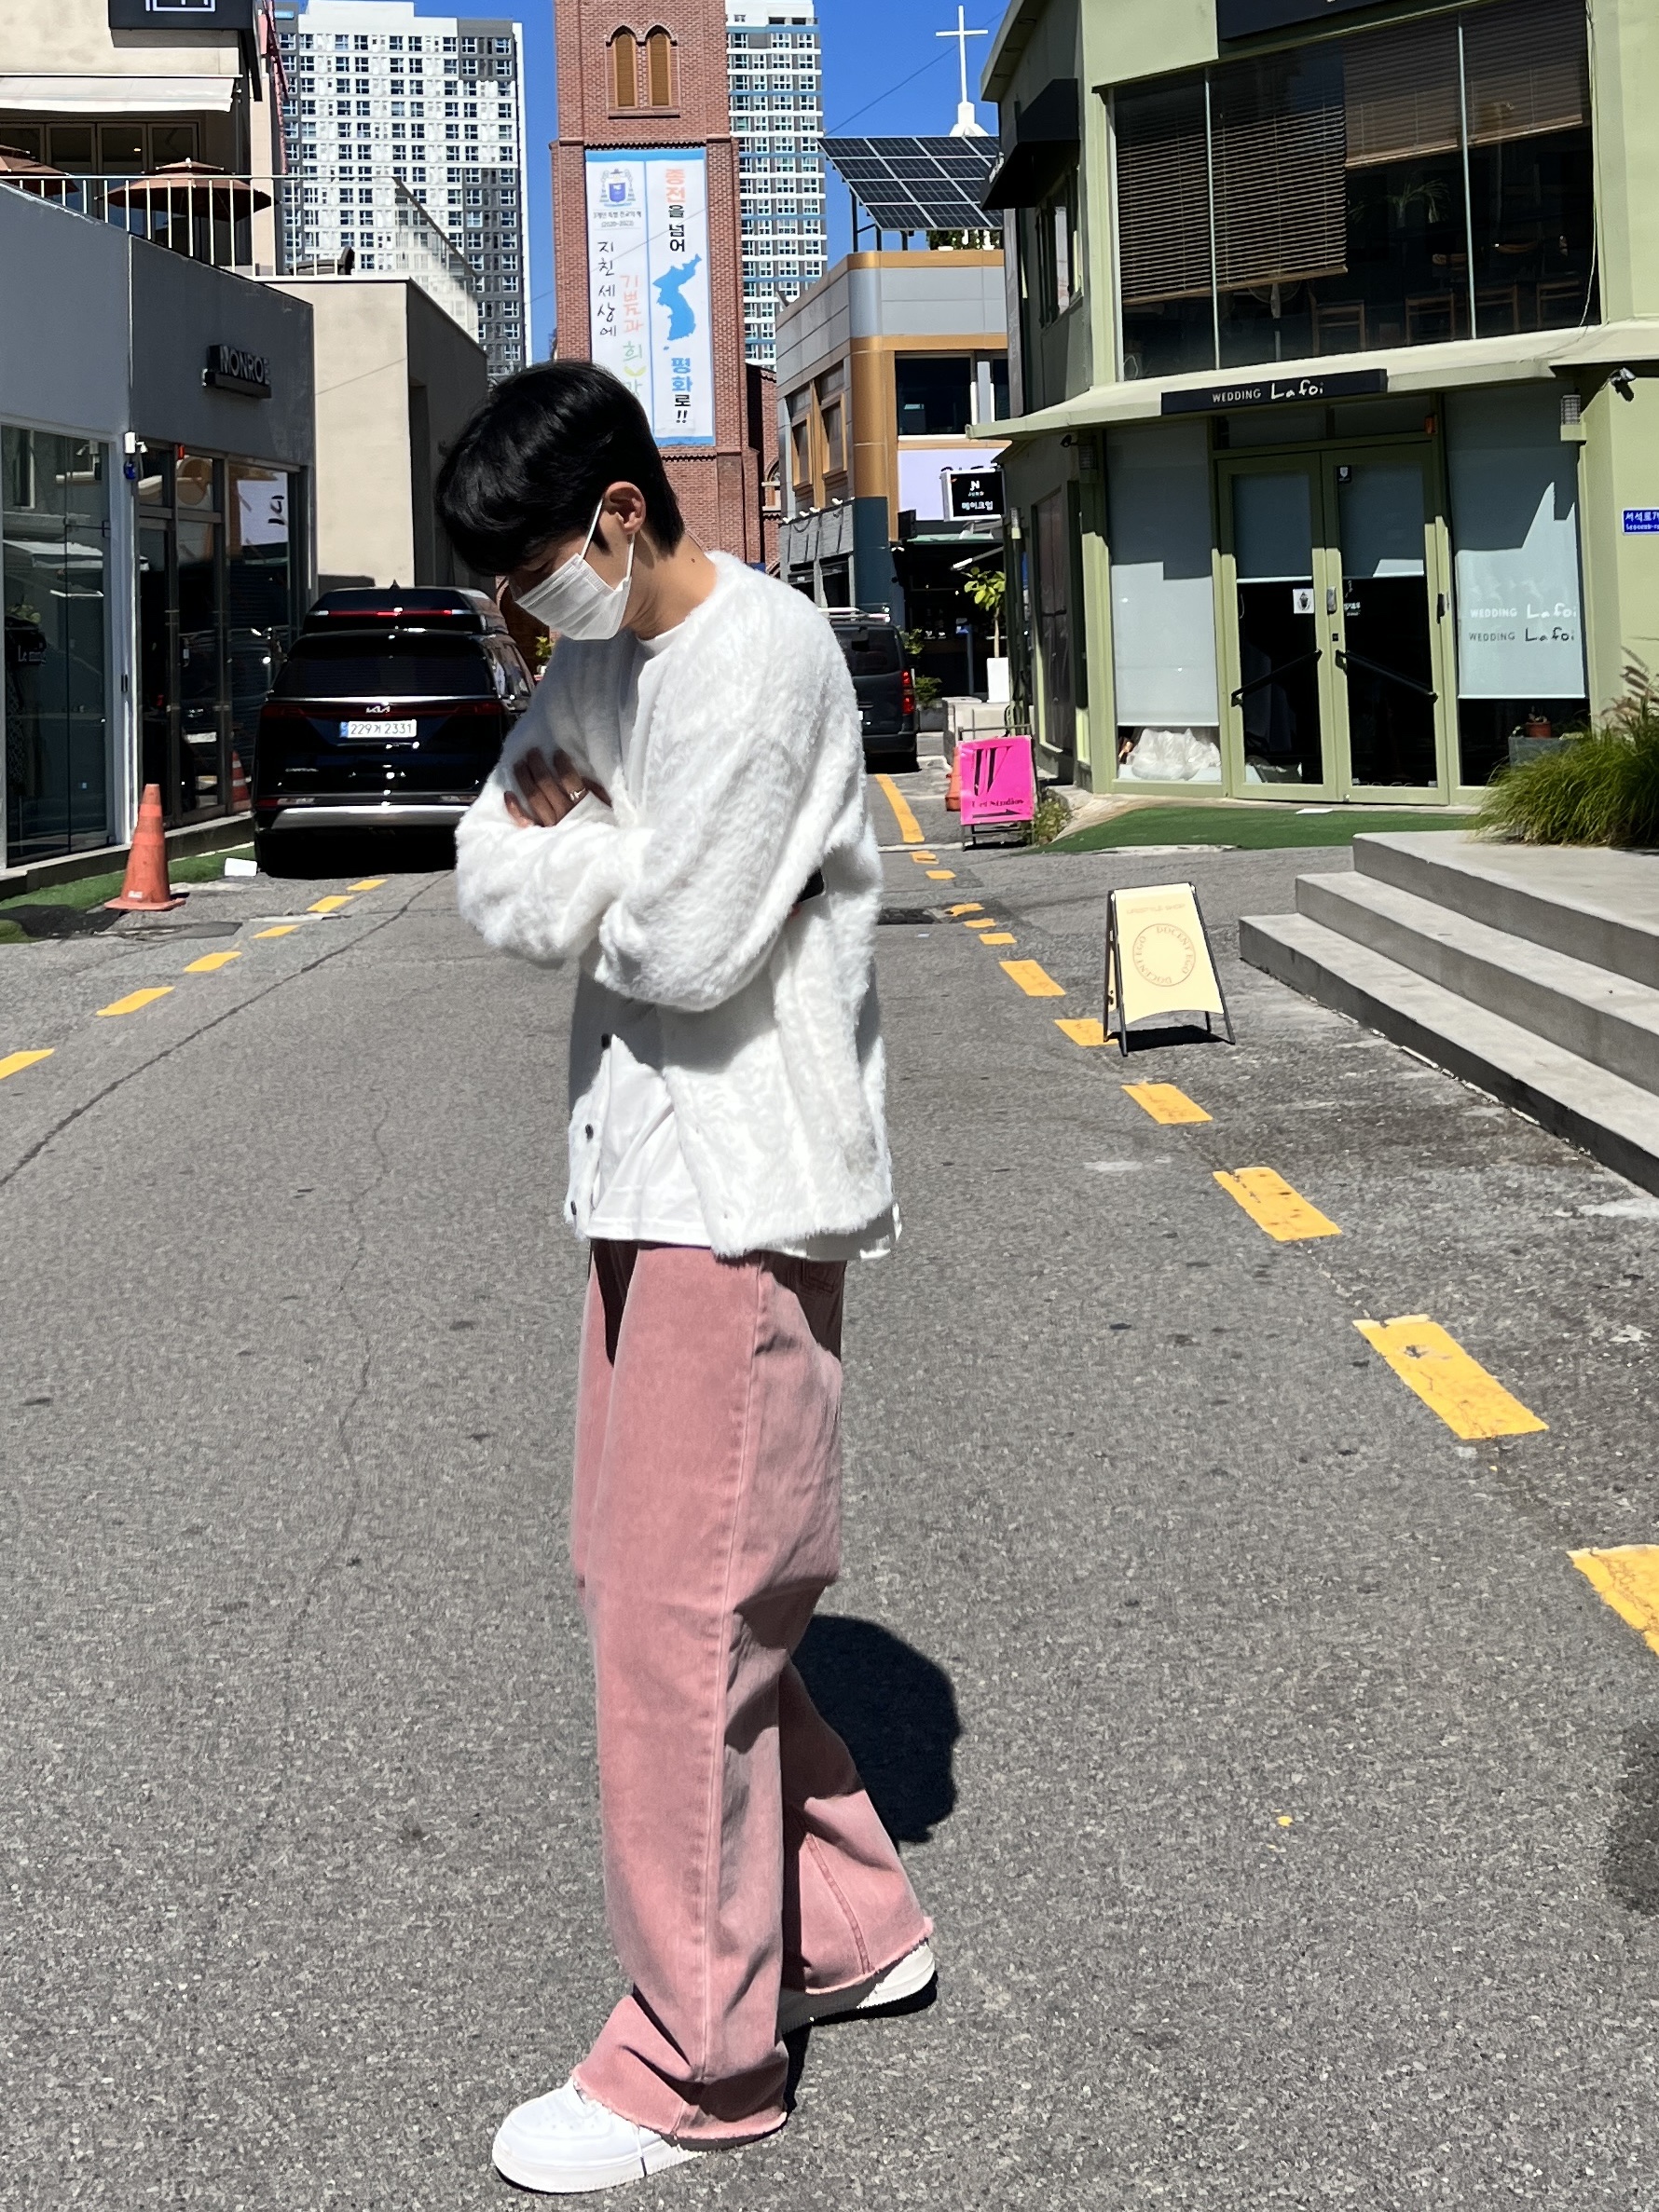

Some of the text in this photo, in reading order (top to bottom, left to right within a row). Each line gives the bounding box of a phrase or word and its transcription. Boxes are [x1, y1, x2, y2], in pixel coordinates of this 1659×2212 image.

[668, 224, 685, 253] 넘어
[596, 241, 617, 336] 지친 세상에
[1212, 389, 1262, 403] WEDDING
[1470, 608, 1518, 619] WEDDING
[384, 723, 411, 734] 2331
